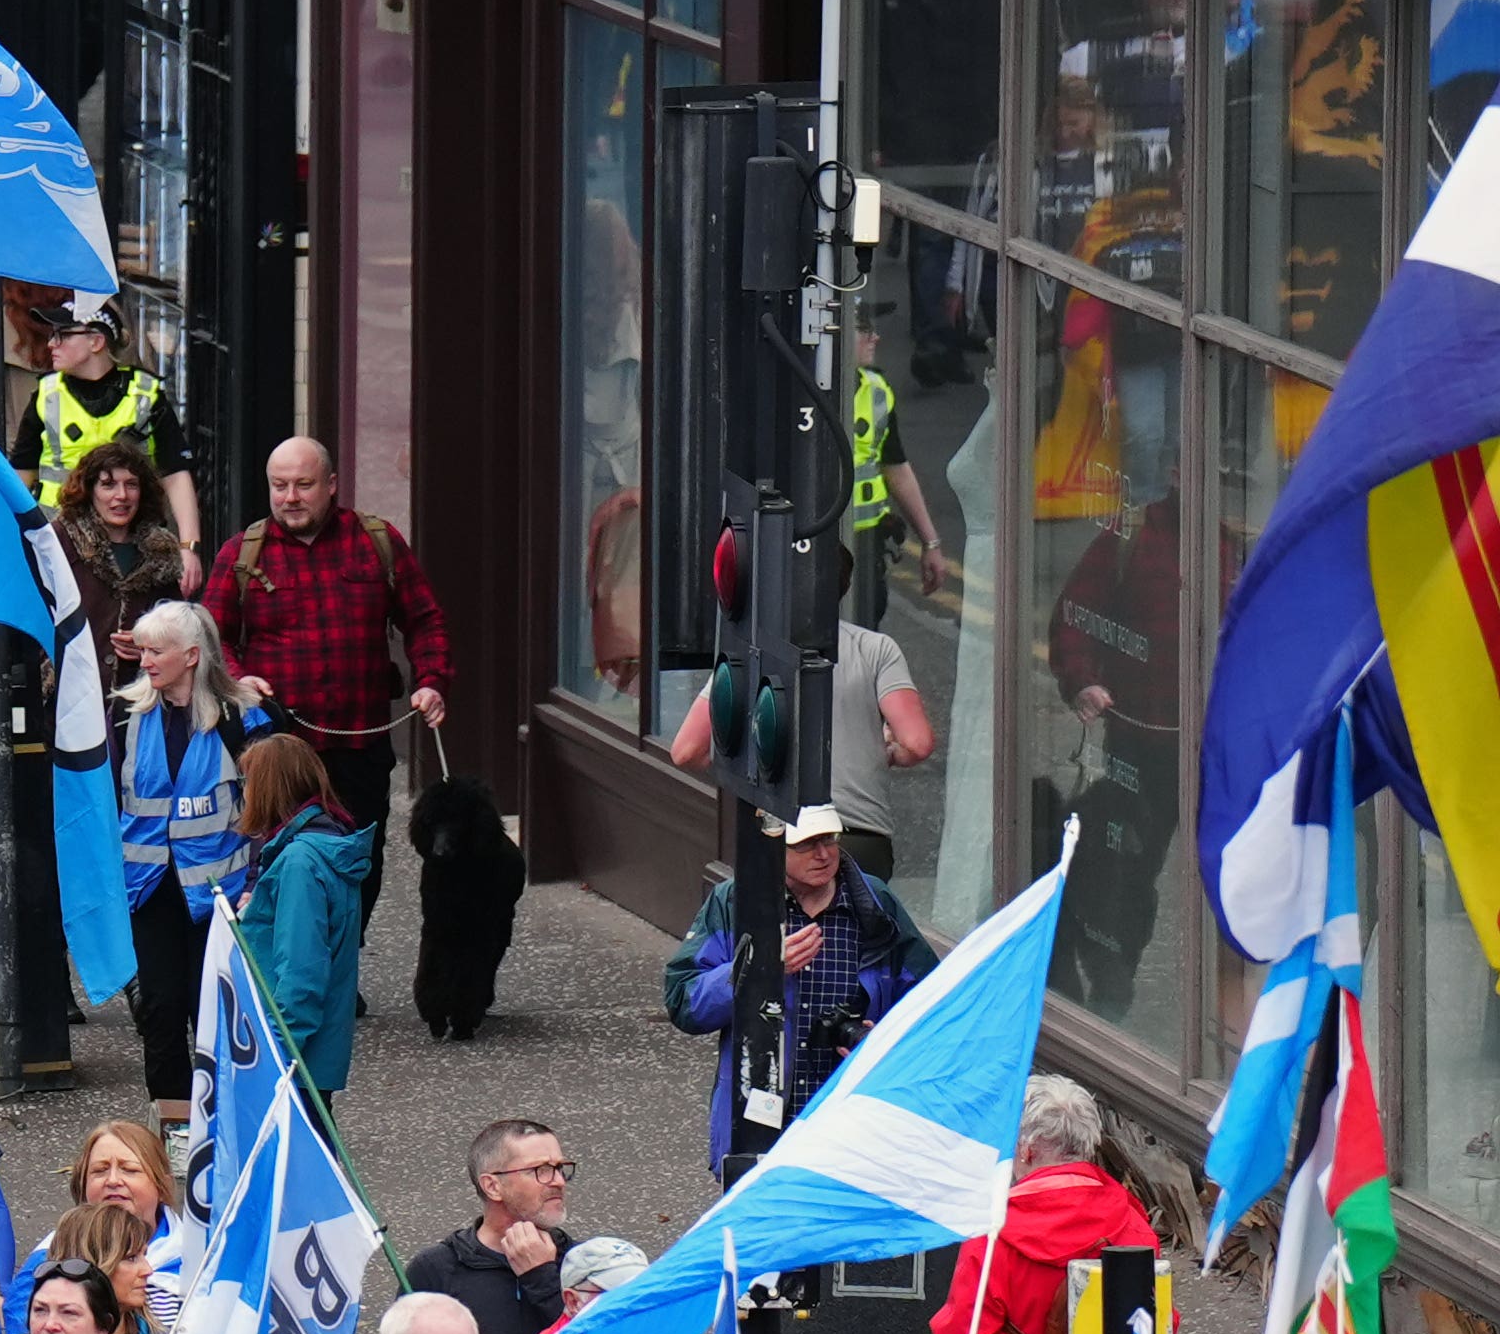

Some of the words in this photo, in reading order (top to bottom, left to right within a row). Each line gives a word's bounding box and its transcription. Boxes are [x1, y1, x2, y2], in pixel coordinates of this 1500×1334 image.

[797, 407, 814, 432] 3
[1075, 603, 1117, 650] APPOINTMENT
[1117, 623, 1149, 663] REQUIRED
